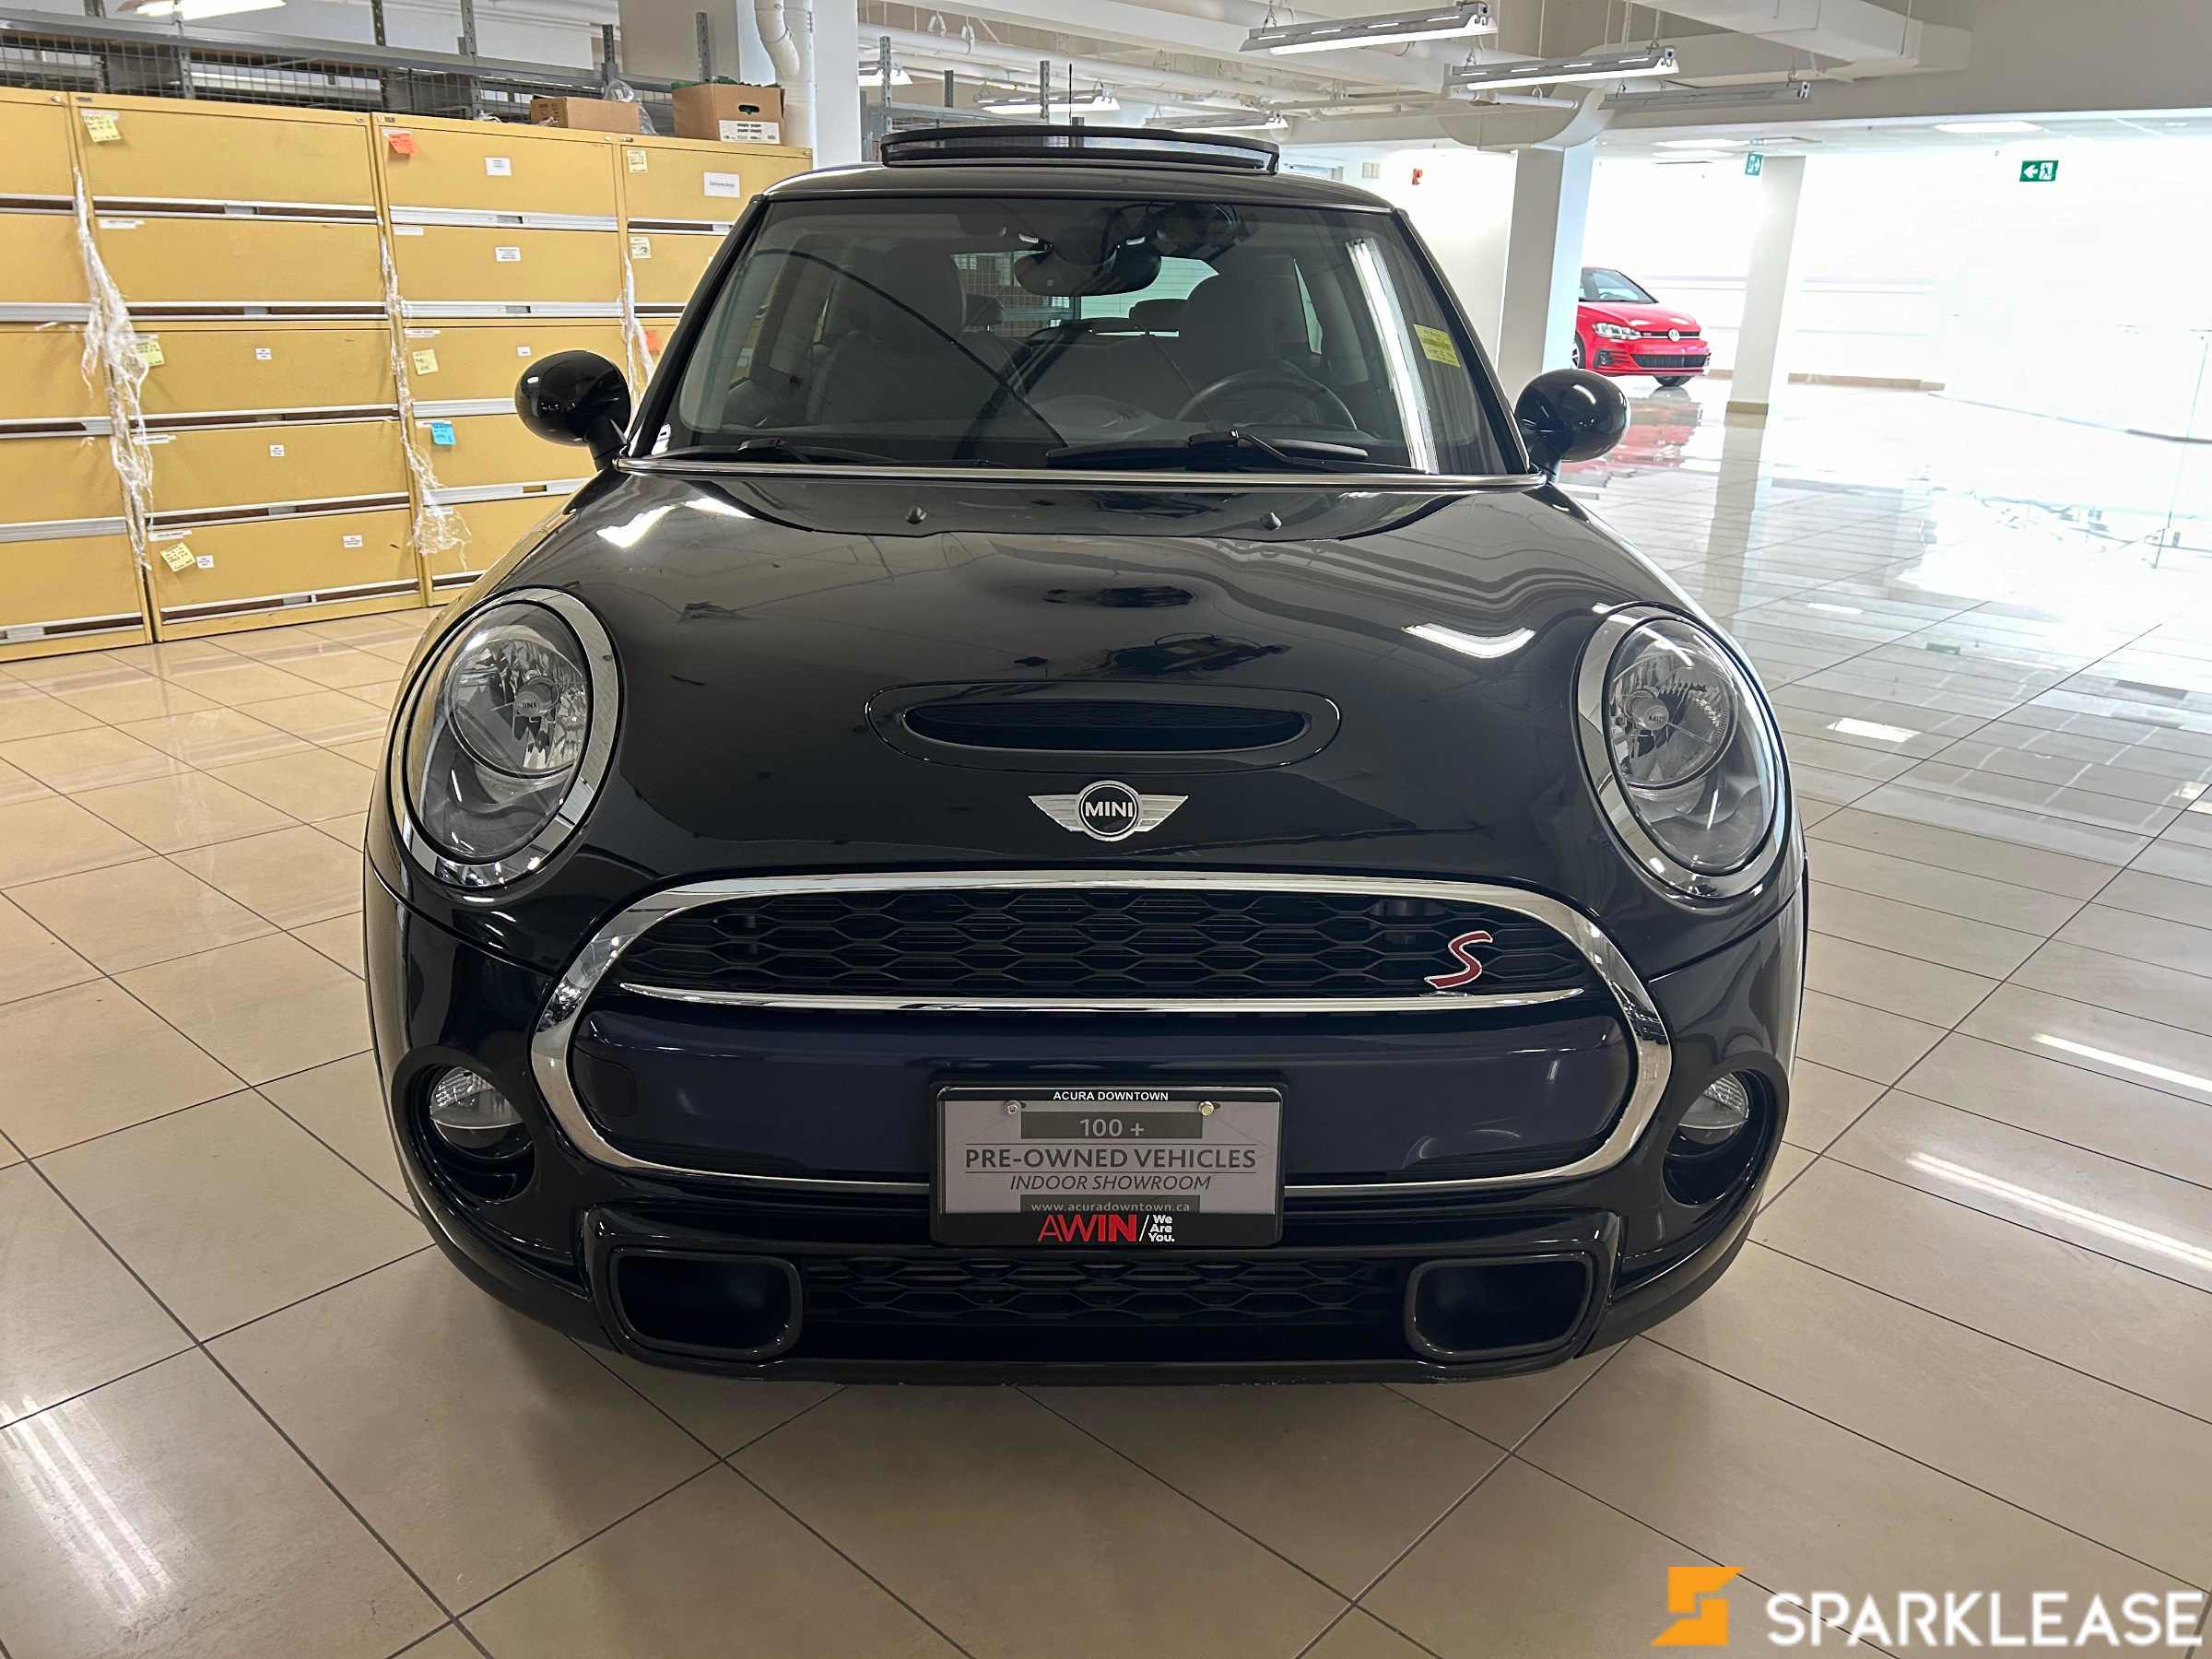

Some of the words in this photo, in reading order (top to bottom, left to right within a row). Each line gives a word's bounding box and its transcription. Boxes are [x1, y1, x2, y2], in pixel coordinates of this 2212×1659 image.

[1085, 801, 1134, 818] MINI
[1423, 930, 1494, 990] S
[1053, 1091, 1095, 1100] ACURA
[1097, 1091, 1170, 1100] DOWNTOWN
[1079, 1118, 1124, 1136] 100
[965, 1148, 1128, 1168] PRE-OWNED
[1133, 1148, 1256, 1169] VEHICLES
[1010, 1175, 1088, 1190] INDOOR
[1092, 1175, 1212, 1190] SHOWROOM
[1030, 1201, 1190, 1212] www.acuradowntown.ca
[1152, 1214, 1173, 1224] We
[1149, 1224, 1173, 1233] Are
[1147, 1232, 1175, 1242] You.
